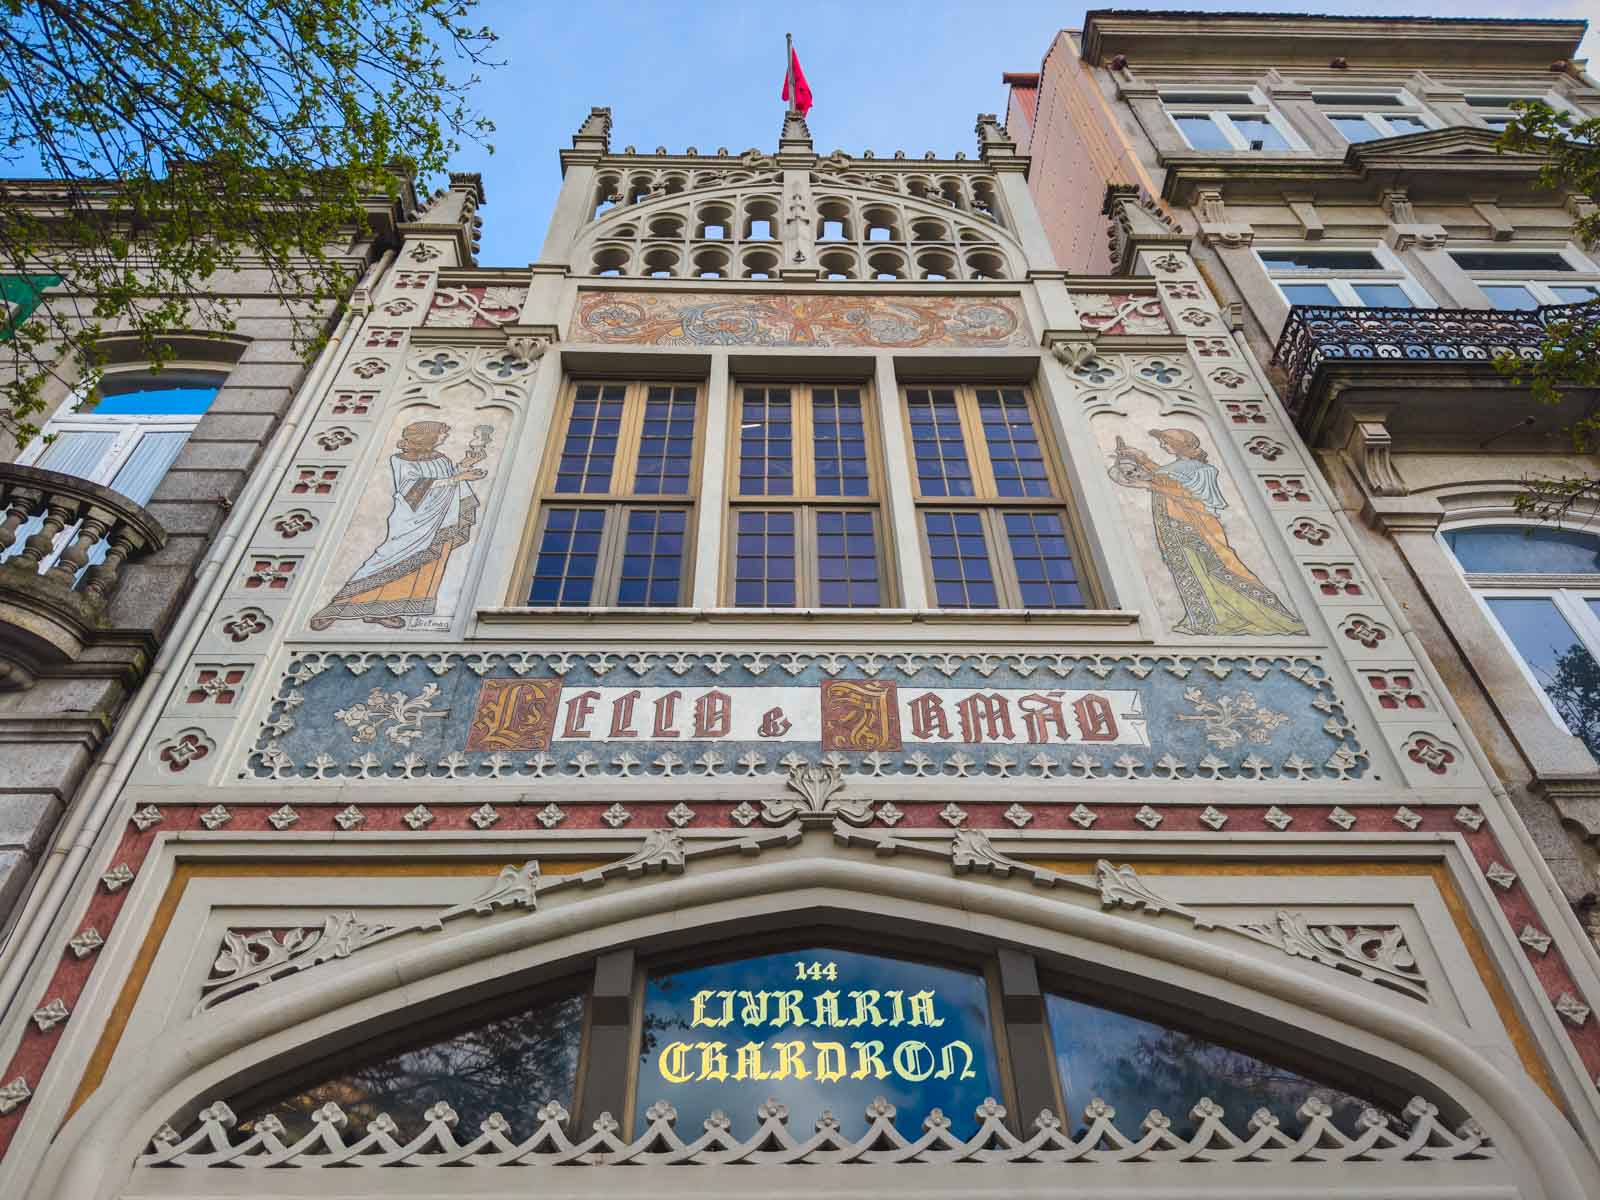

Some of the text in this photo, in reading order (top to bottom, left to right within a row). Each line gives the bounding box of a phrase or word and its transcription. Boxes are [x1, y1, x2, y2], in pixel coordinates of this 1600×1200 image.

[757, 705, 793, 738] &
[794, 961, 838, 982] 144
[690, 989, 945, 1028] LIVRARIA
[658, 1040, 977, 1084] CHARDRON
